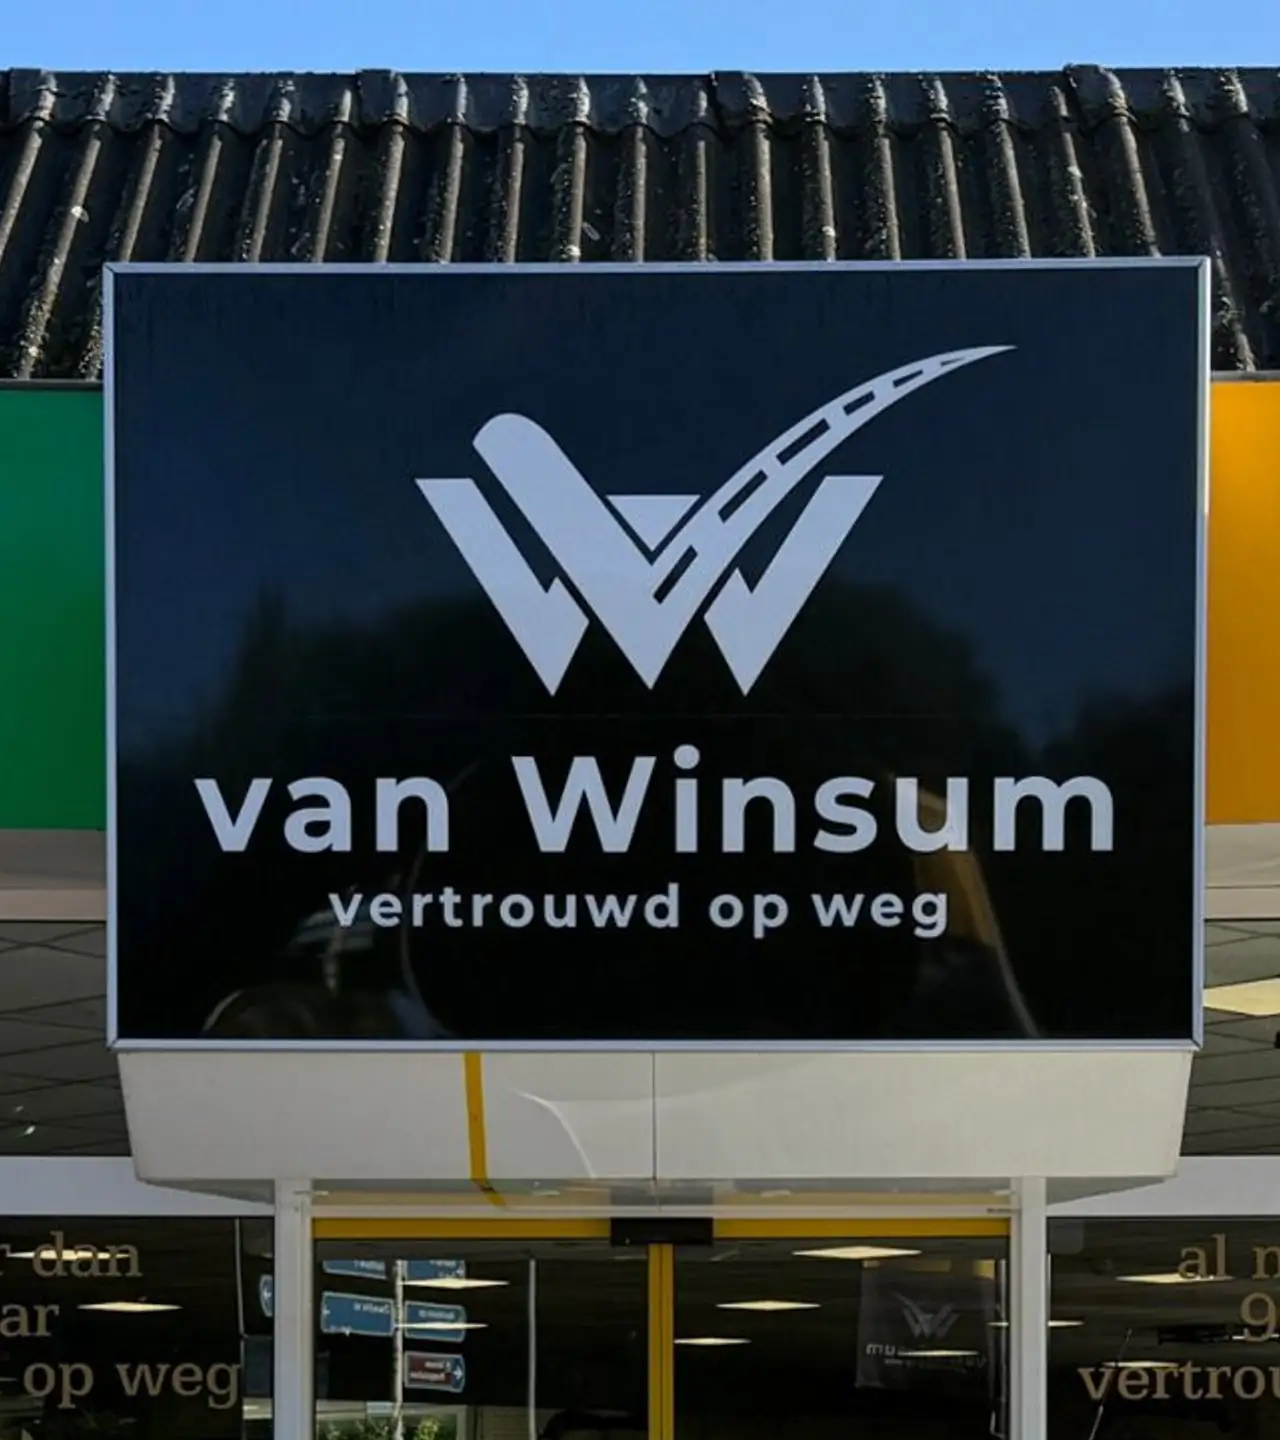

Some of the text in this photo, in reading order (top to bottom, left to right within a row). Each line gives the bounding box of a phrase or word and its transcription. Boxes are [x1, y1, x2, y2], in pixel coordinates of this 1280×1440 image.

[194, 743, 1114, 855] van Winsum
[329, 883, 951, 938] vertrouwd op weg
[32, 1232, 143, 1278] dan
[1176, 1233, 1227, 1280] al
[24, 1361, 94, 1408] op
[116, 1361, 244, 1408] weg
